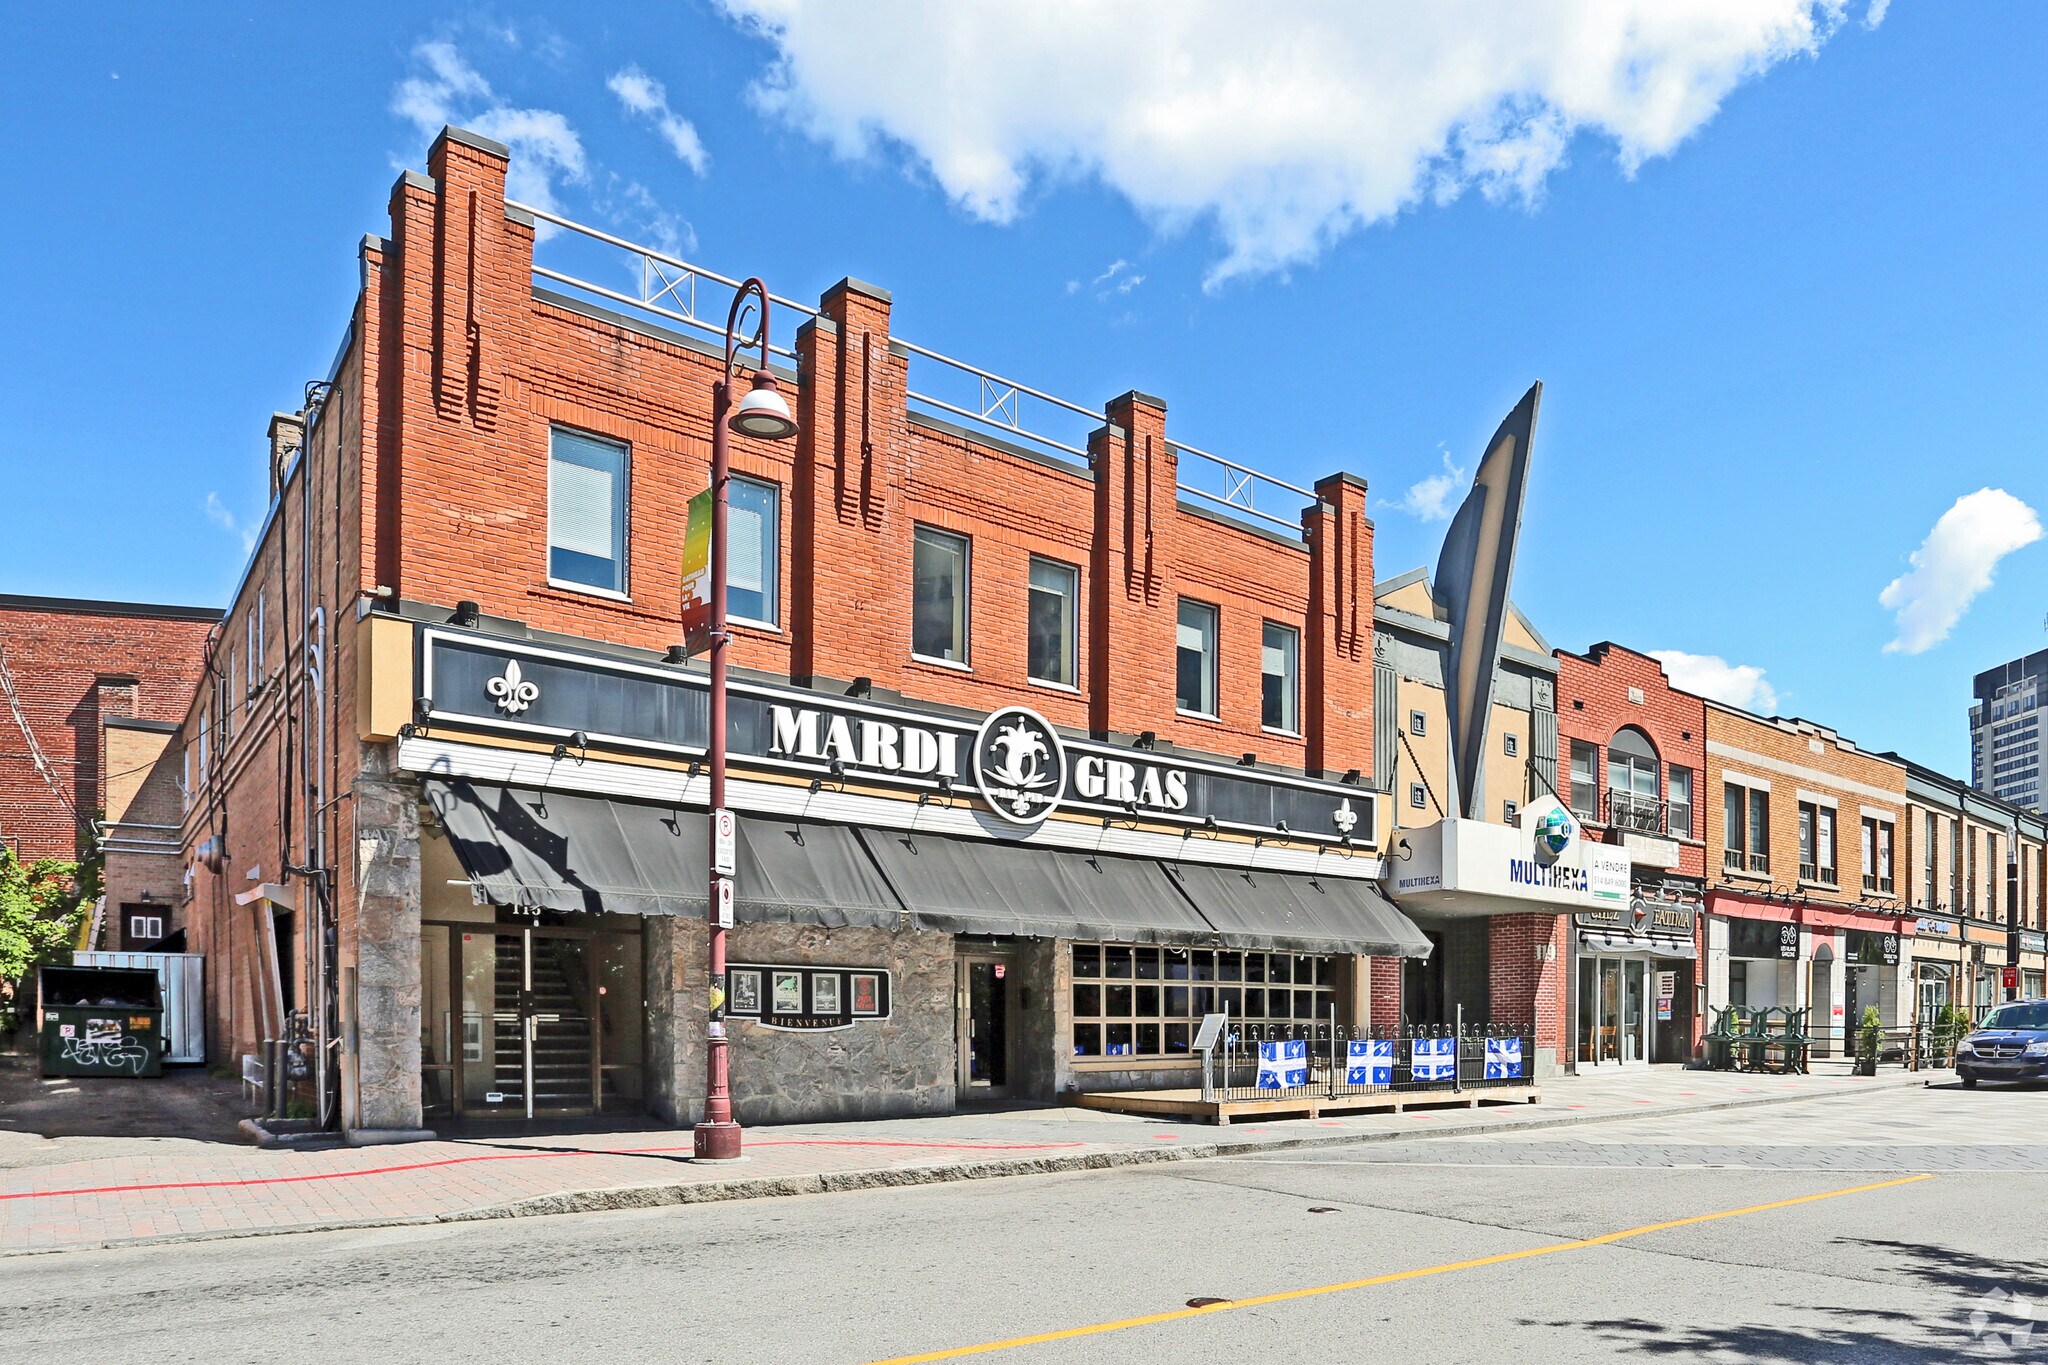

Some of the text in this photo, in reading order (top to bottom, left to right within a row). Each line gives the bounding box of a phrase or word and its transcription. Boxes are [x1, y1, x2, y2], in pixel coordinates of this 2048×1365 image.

[769, 704, 1188, 810] MARDI GRAS
[1510, 859, 1588, 892] MULTIHEXA
[1601, 861, 1628, 874] VENDRE
[1399, 875, 1440, 888] MULTIHEXA
[1653, 908, 1690, 928] FATIMA
[1534, 943, 1557, 961] 119
[771, 1016, 843, 1028] BIENVENUE
